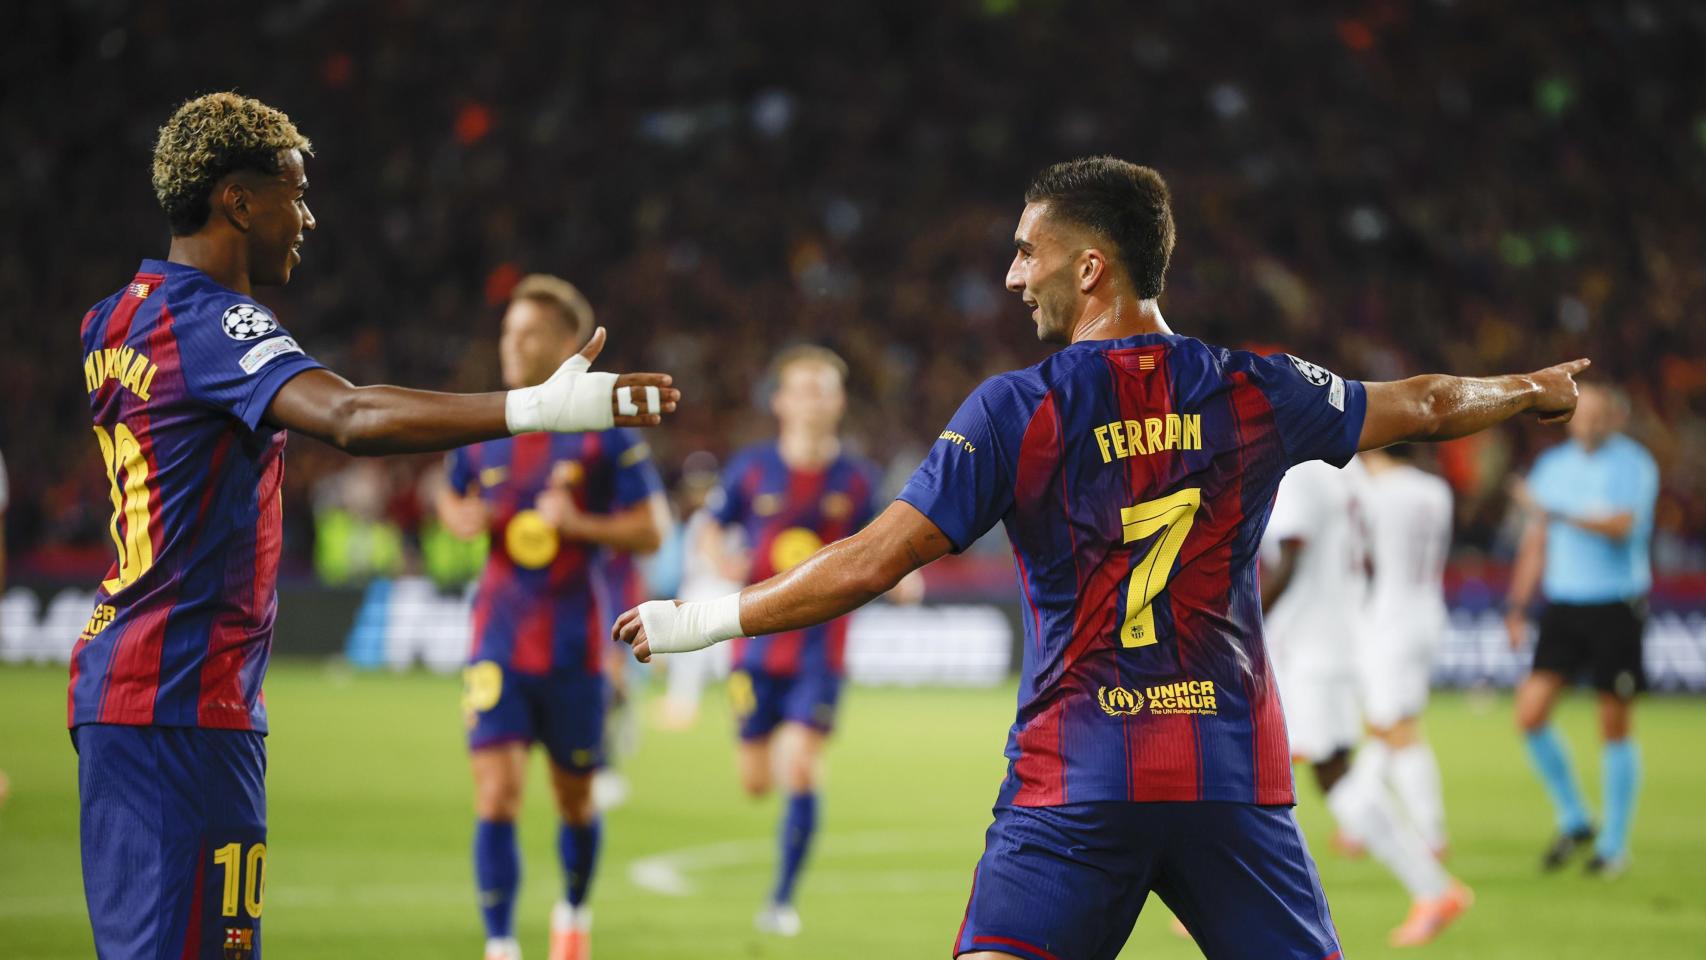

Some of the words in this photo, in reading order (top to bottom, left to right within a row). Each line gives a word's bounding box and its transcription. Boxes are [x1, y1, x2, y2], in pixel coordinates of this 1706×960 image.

[939, 430, 965, 445] LIGHT
[964, 441, 976, 454] tv
[1093, 413, 1202, 464] FERRAN
[1120, 487, 1202, 648] 7
[1146, 681, 1215, 699] UNHCR
[1149, 695, 1217, 709] ACNUR
[214, 842, 267, 919] 10
